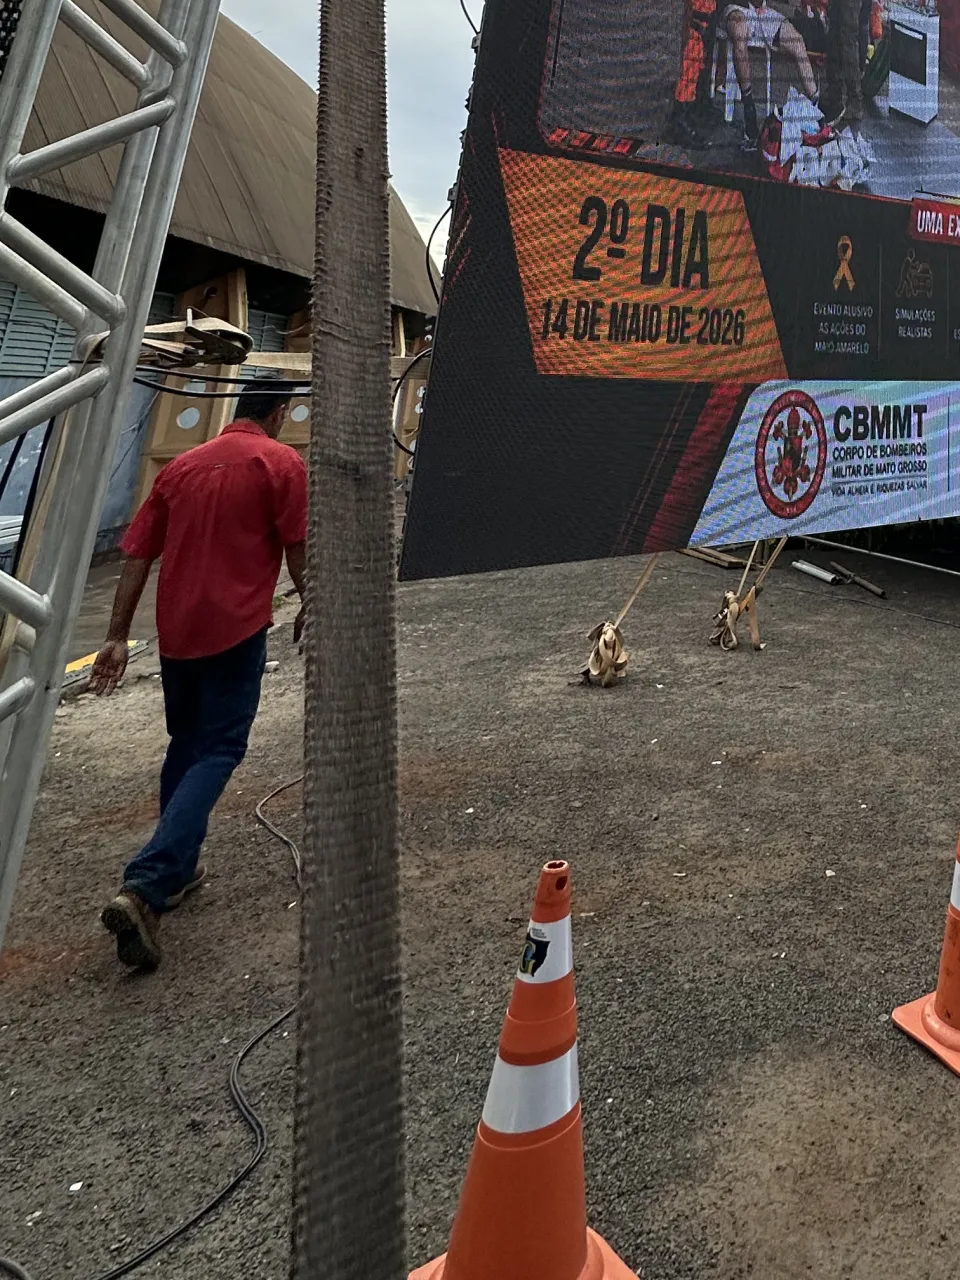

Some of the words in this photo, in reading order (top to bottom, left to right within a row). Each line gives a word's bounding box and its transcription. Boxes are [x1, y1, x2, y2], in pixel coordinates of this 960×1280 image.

[917, 210, 943, 235] UMA
[571, 195, 629, 283] 2º
[640, 203, 710, 291] DIA
[813, 302, 841, 316] EVENTO
[843, 305, 873, 318] ALUSIVO
[895, 308, 936, 323] SIMULAÇÕES
[541, 298, 569, 341] 14
[573, 299, 604, 342] DE
[608, 302, 662, 343] MAIO
[666, 306, 693, 344] DE
[696, 307, 746, 346] 2026
[855, 324, 866, 336] DO
[898, 326, 933, 338] REALISTAS
[835, 342, 870, 354] AMARELO
[833, 404, 927, 442] CBMMT
[832, 446, 864, 460] CORPO
[866, 445, 879, 459] DE
[880, 442, 927, 458] BOMBEIROS
[832, 463, 862, 478] MILITAR
[864, 463, 873, 476] DE
[876, 462, 896, 475] MATO
[897, 460, 927, 474] GROSSO
